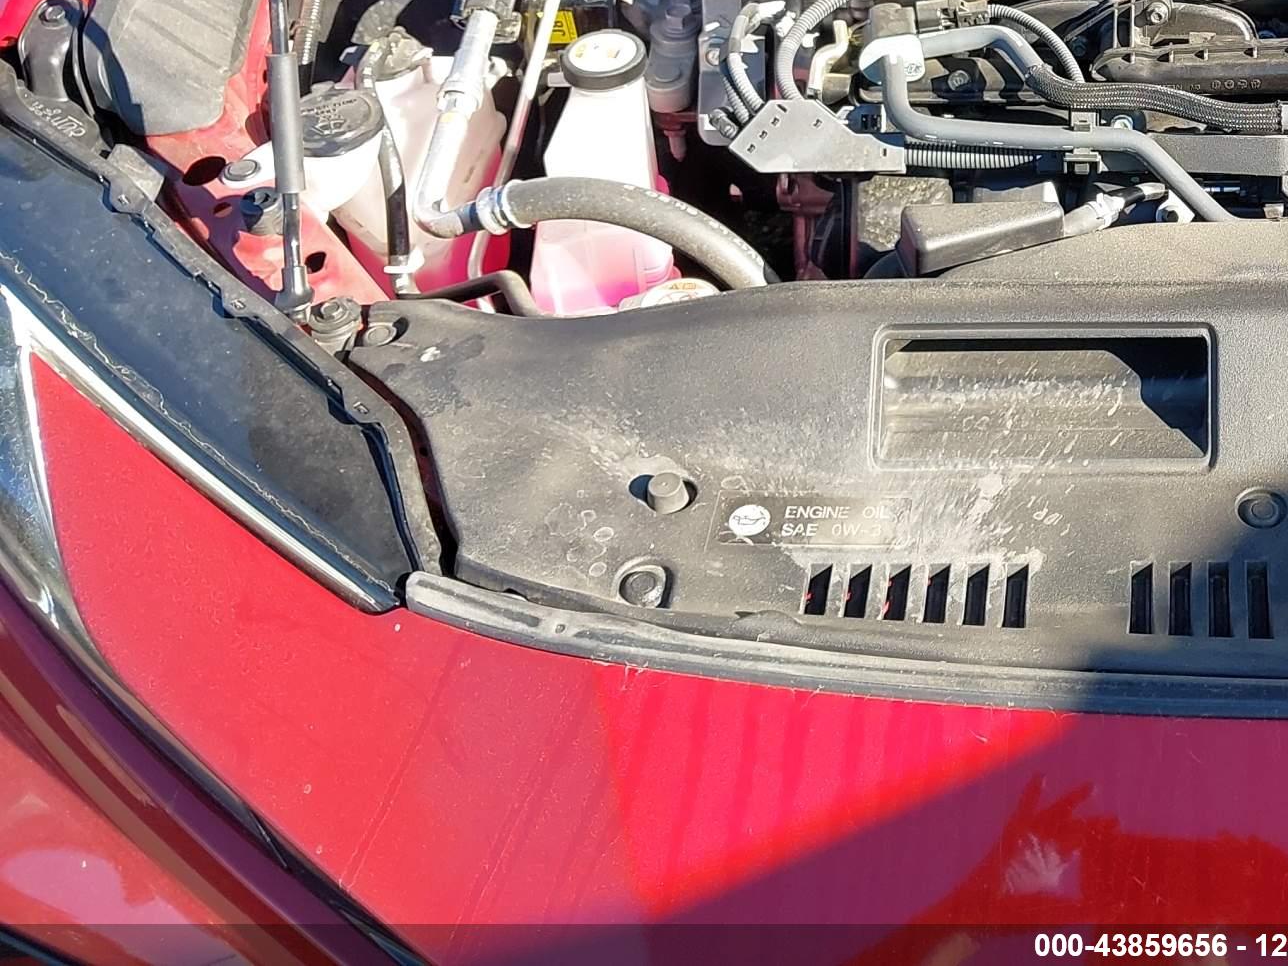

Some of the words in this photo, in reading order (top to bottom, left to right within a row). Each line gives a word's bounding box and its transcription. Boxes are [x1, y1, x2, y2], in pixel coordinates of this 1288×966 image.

[785, 505, 850, 519] ENGINE
[862, 505, 891, 519] OIL
[781, 522, 819, 537] SAE
